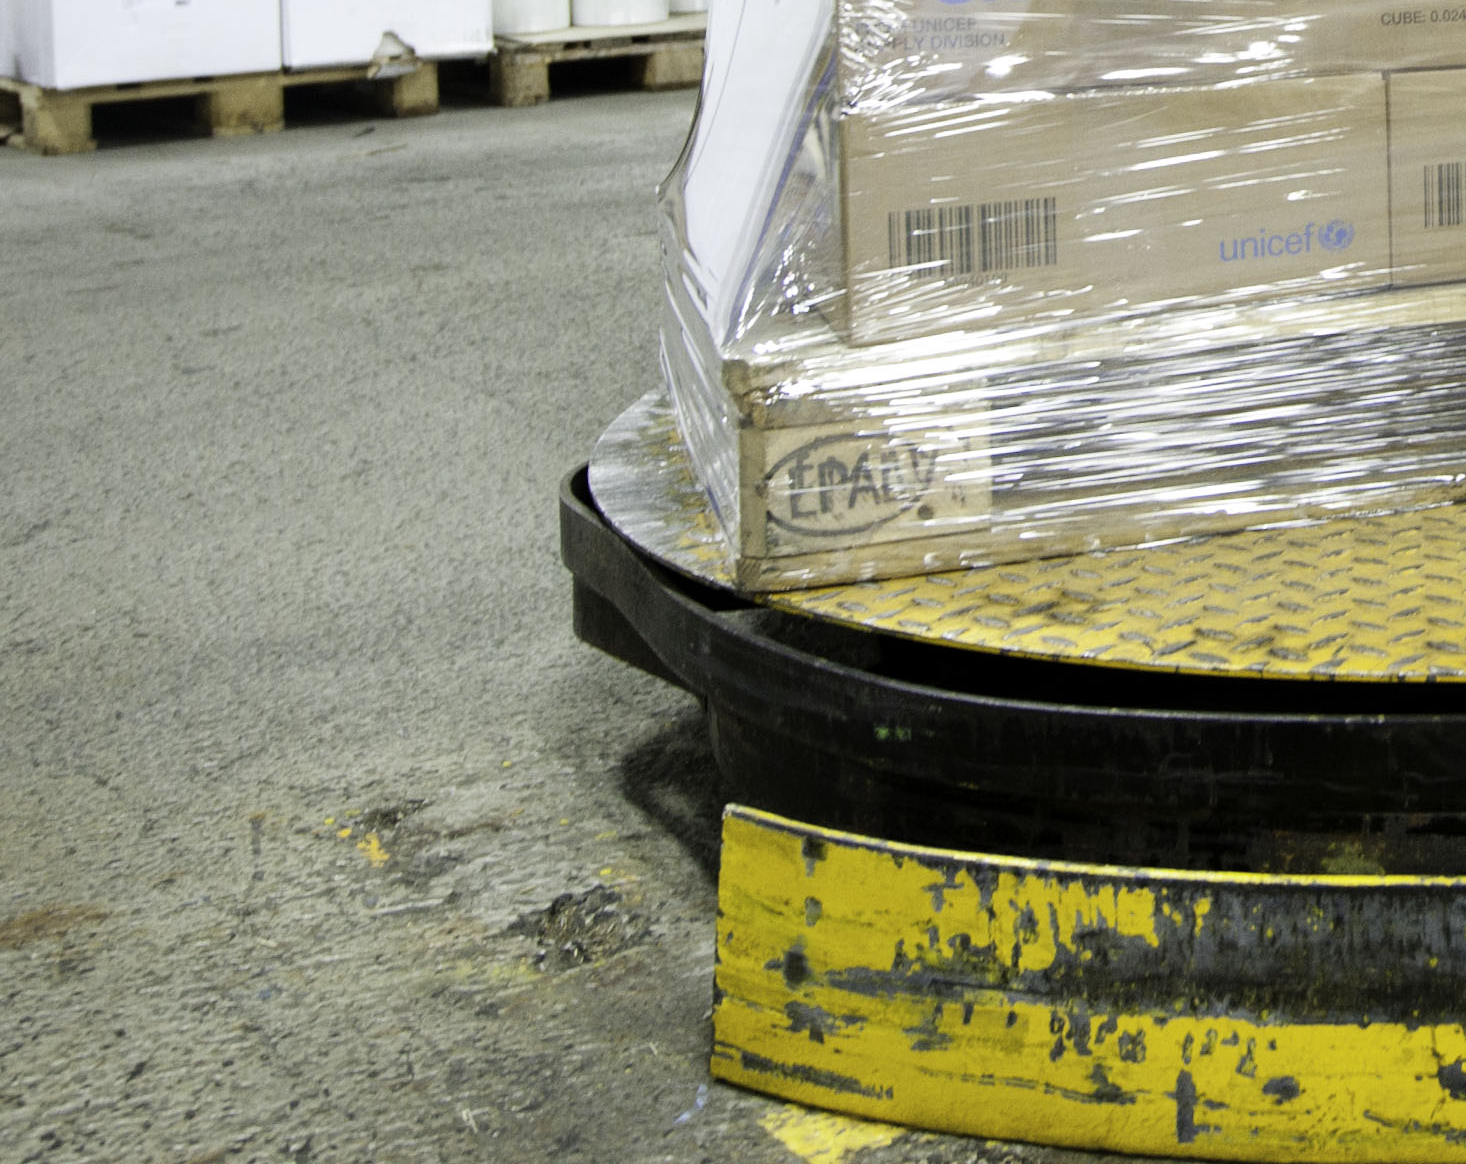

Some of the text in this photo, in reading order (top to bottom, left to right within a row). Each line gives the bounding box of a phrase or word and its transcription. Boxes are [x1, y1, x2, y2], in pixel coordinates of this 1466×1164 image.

[1381, 10, 1426, 25] CUBE:
[1430, 9, 1466, 23] 0.024
[930, 32, 1005, 50] DIVISION
[1220, 222, 1315, 261] unicef
